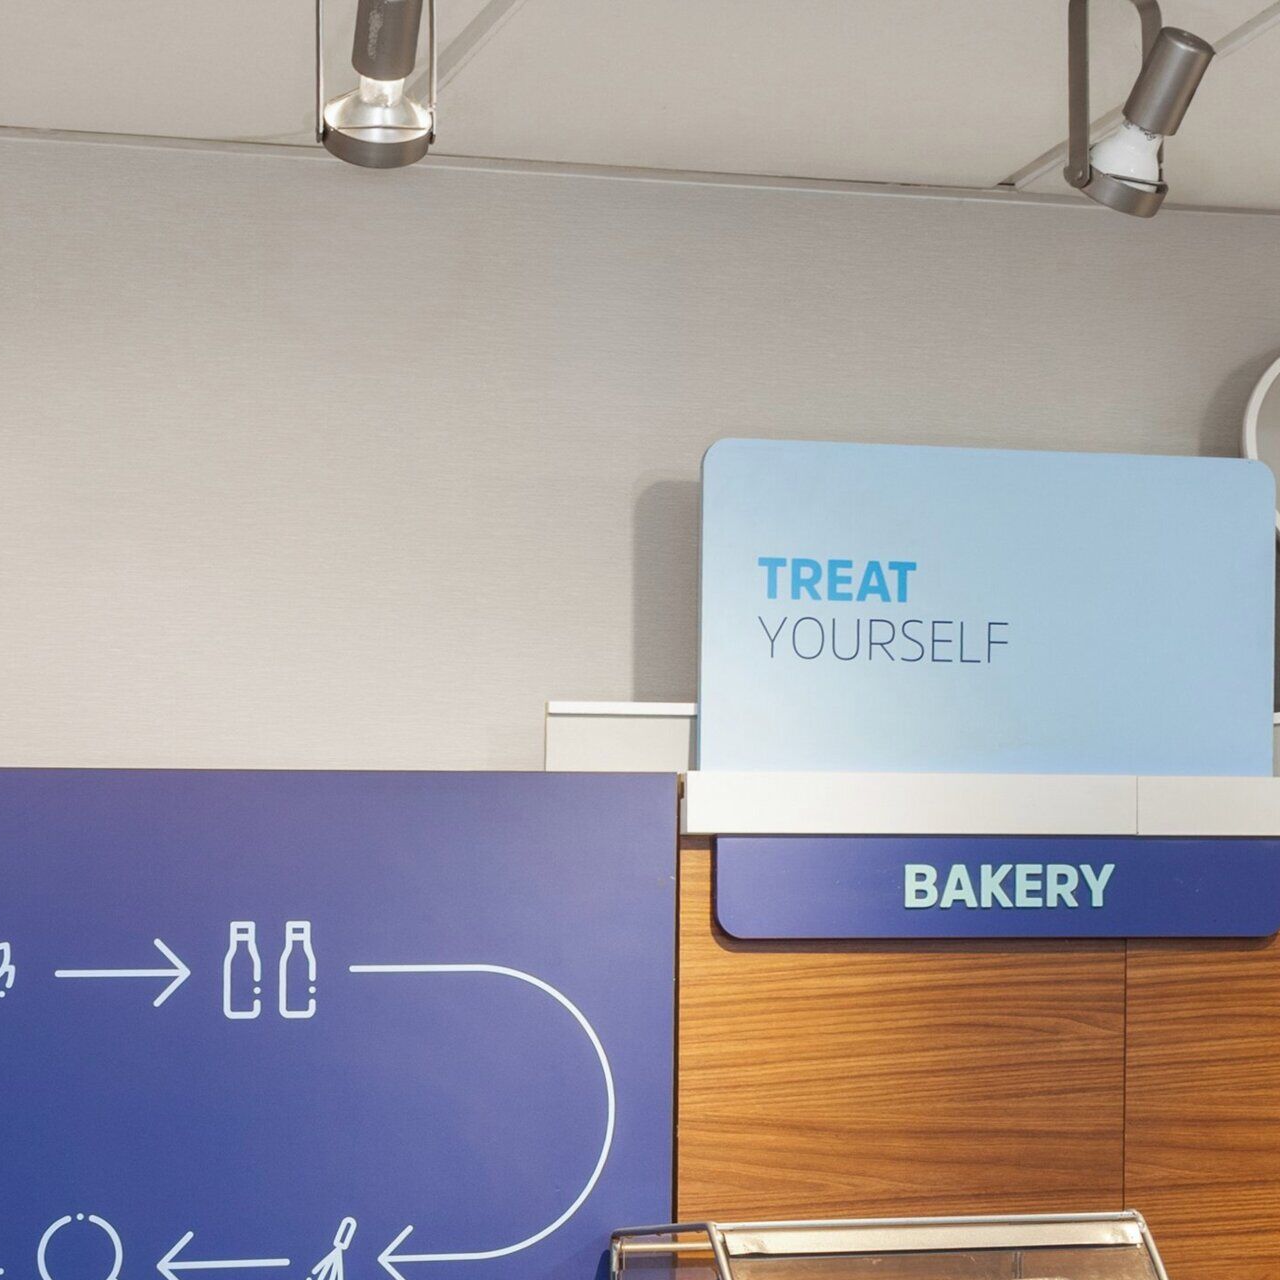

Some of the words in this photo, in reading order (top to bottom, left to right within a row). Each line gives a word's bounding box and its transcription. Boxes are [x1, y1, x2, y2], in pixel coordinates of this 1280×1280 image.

[757, 556, 918, 604] TREAT
[757, 615, 1011, 665] YOURSELF
[903, 863, 1116, 909] BAKERY
